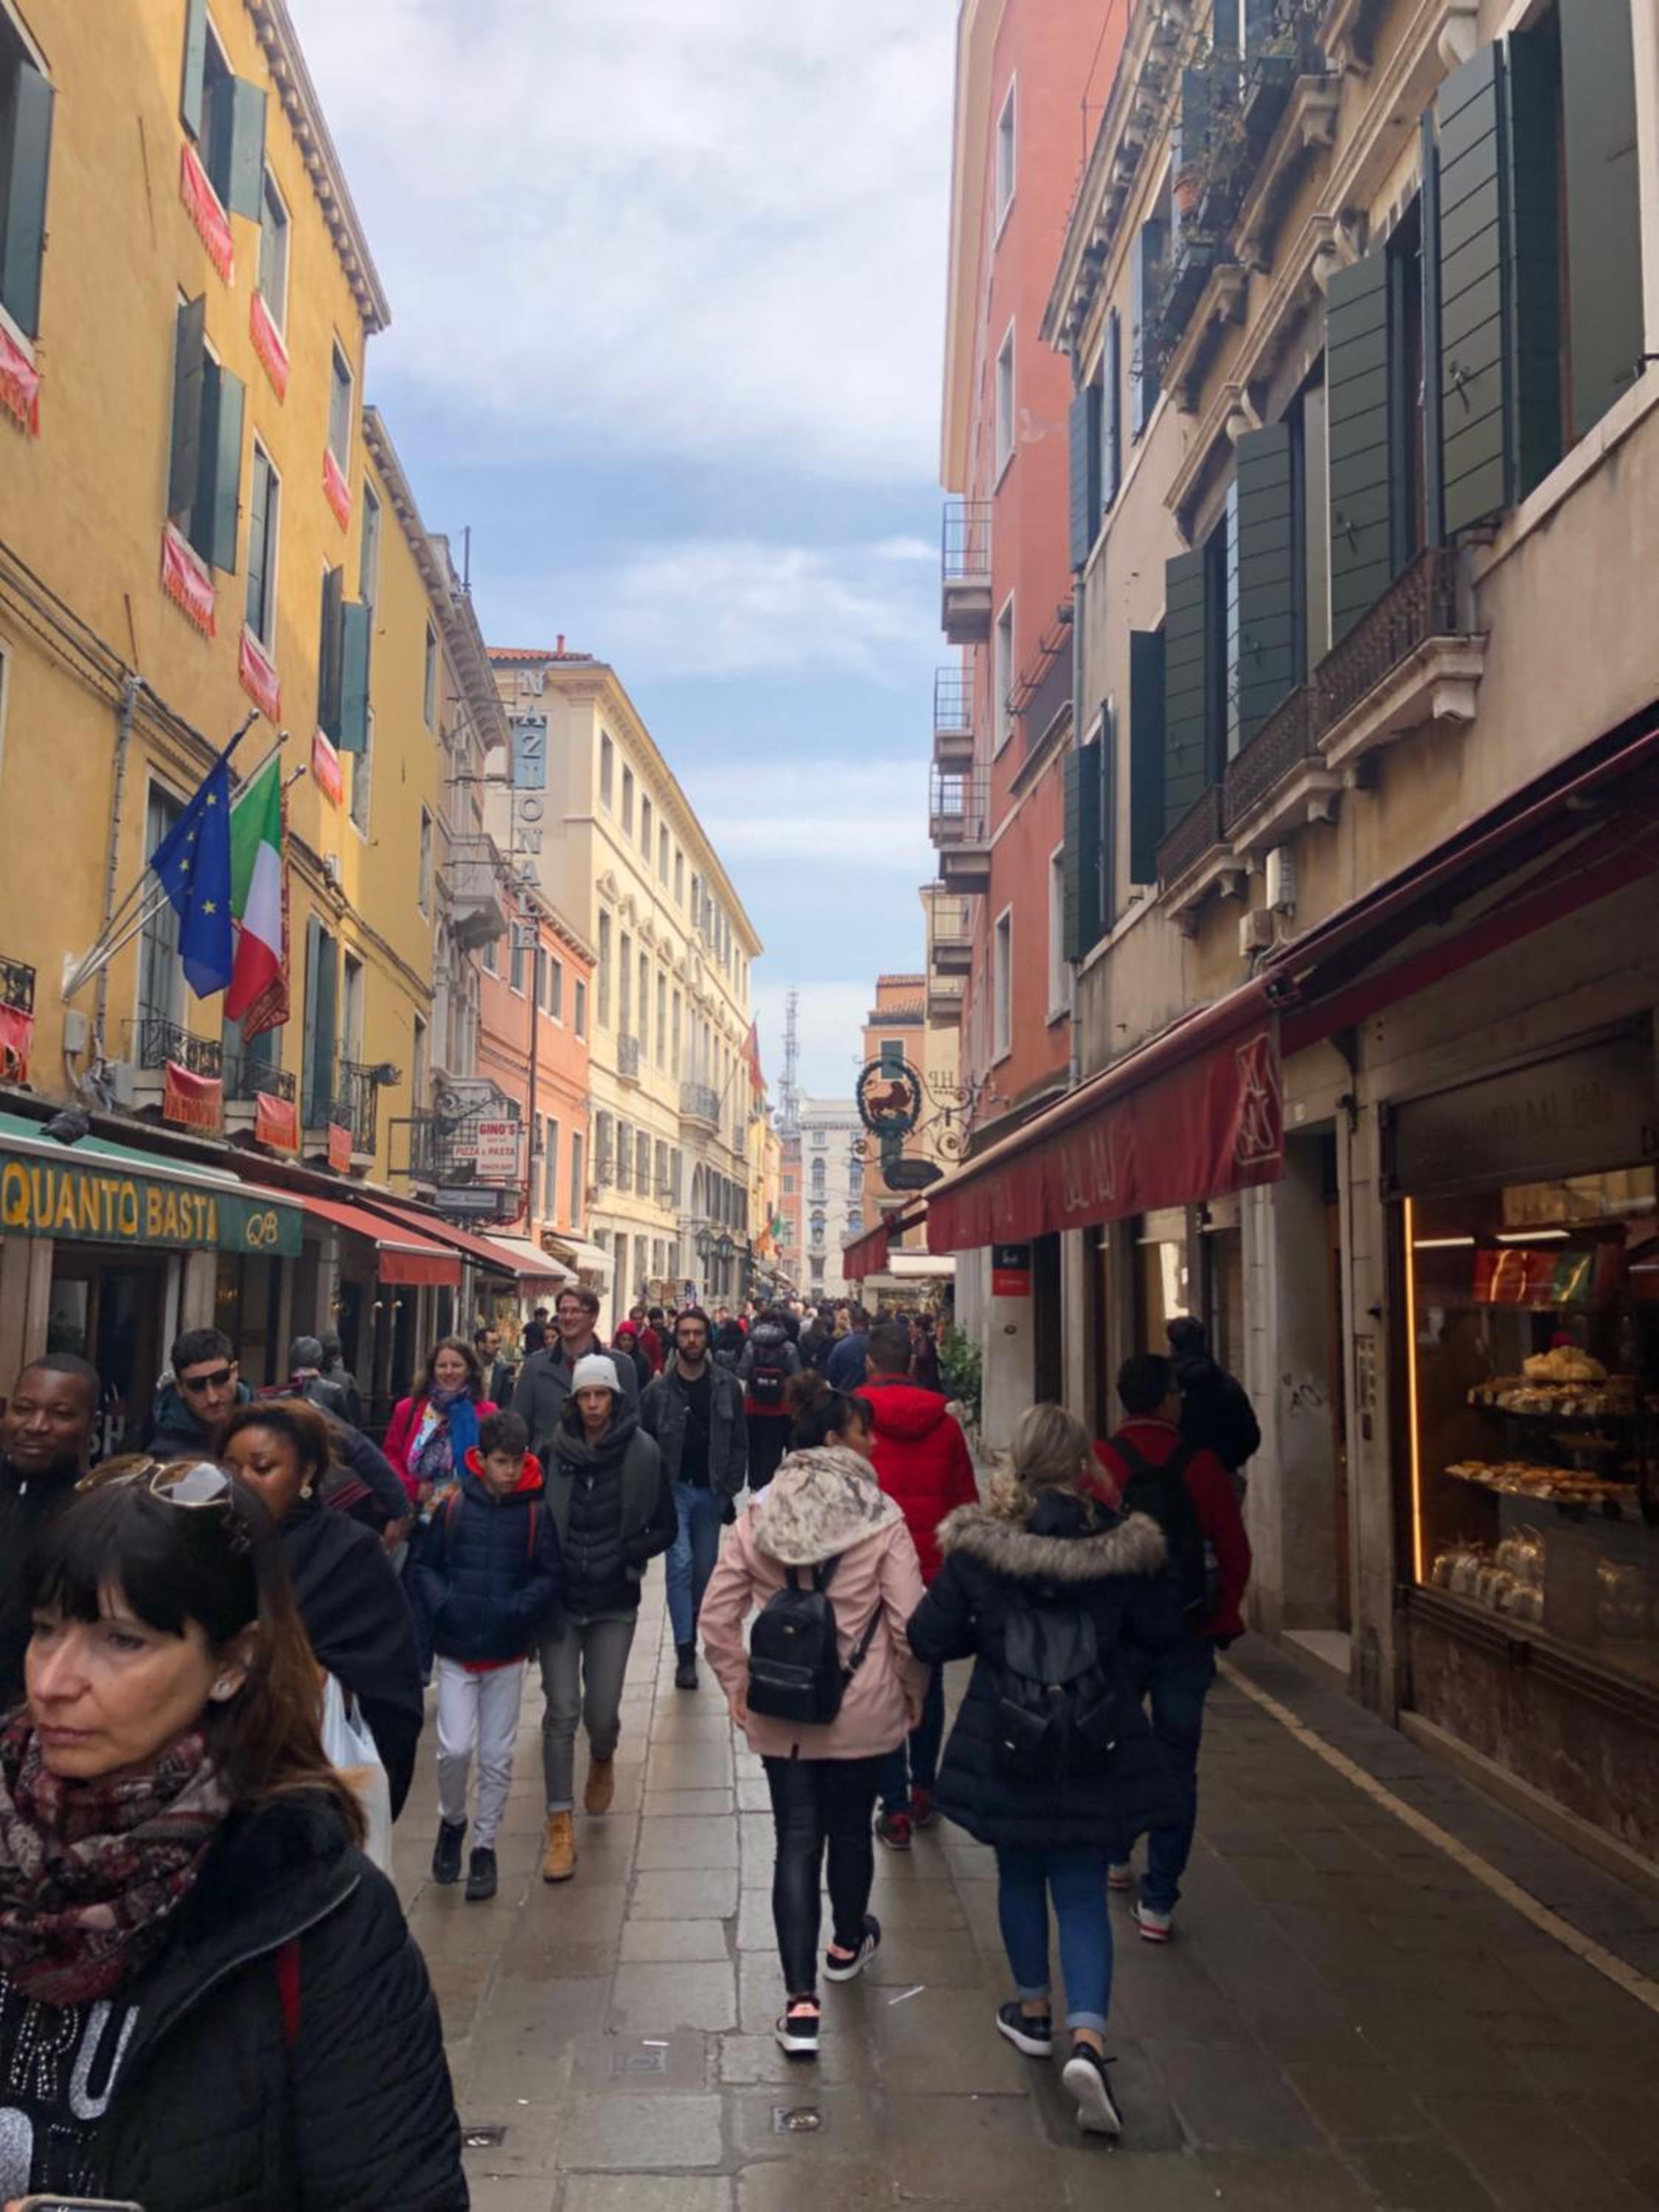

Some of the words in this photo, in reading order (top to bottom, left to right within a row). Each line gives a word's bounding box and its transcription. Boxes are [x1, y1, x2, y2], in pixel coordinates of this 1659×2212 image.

[479, 1123, 515, 1135] GINO'S
[488, 1146, 515, 1156] PASTA
[2, 1161, 139, 1236] QUANTO
